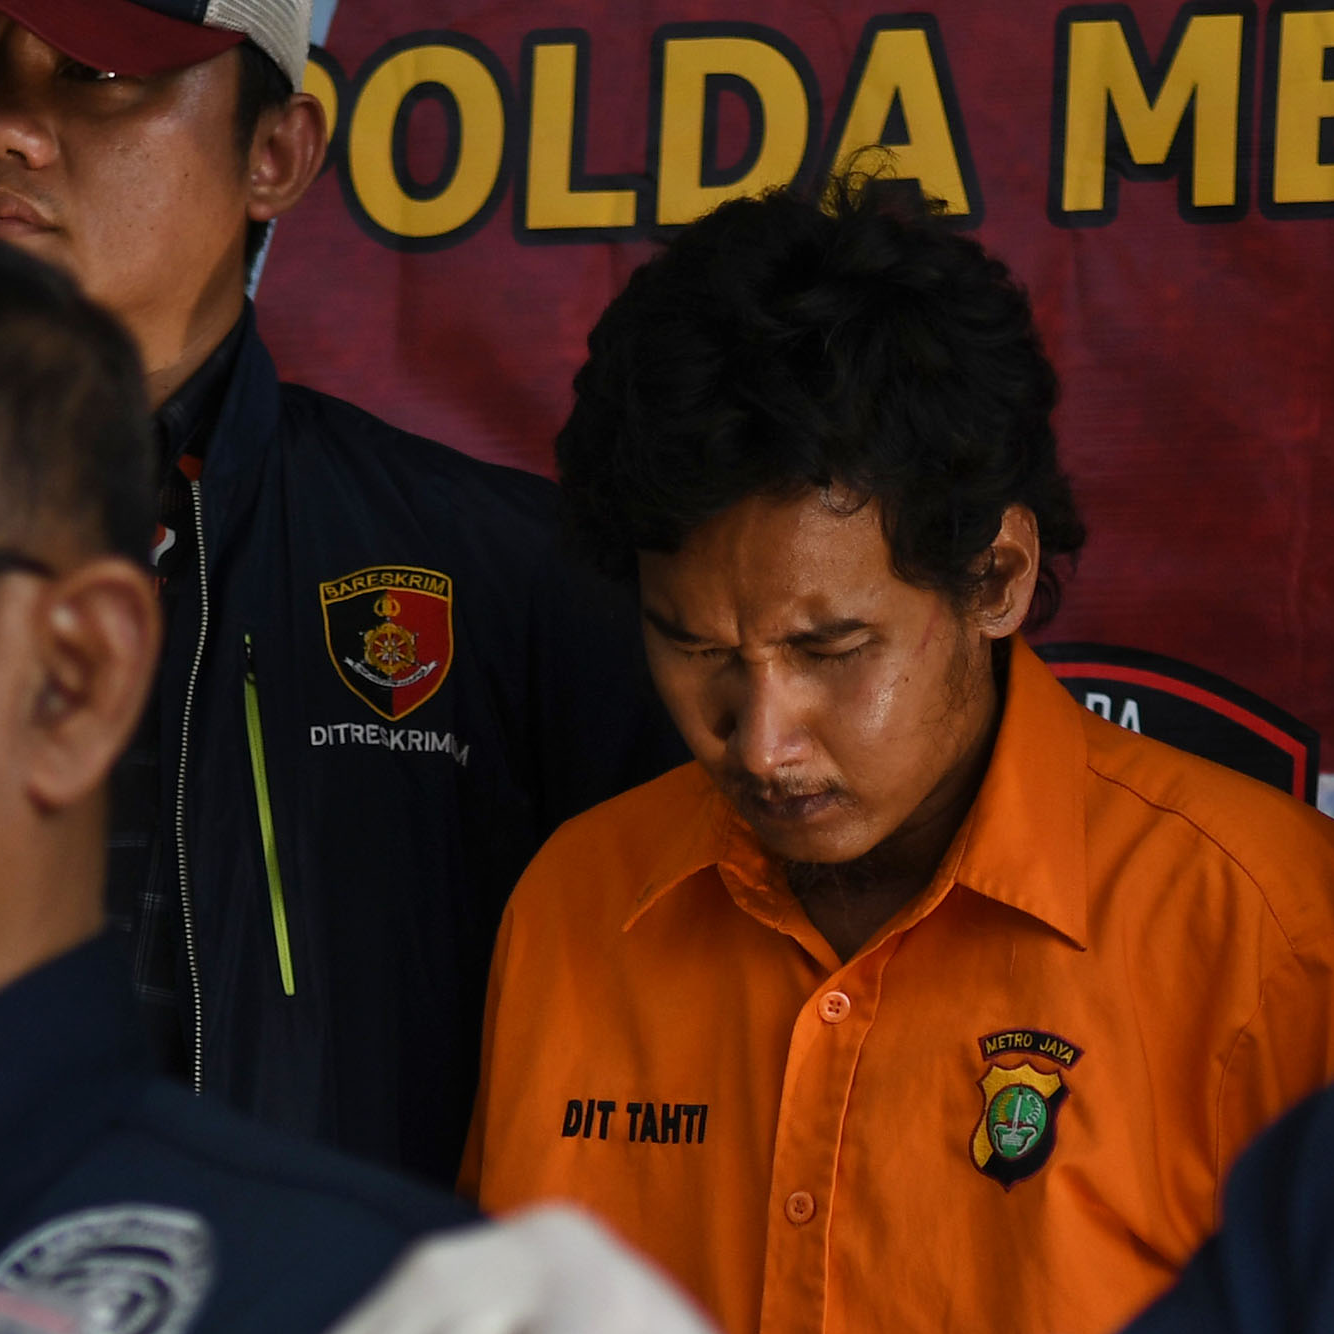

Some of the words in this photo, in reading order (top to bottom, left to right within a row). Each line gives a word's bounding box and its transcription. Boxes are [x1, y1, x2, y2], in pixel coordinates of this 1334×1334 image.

[325, 572, 447, 600] BARESKRIM
[985, 1032, 1034, 1055] METRO
[1039, 1037, 1075, 1066] JAYA
[562, 1099, 616, 1140] DIT
[627, 1102, 709, 1145] TAHTI
